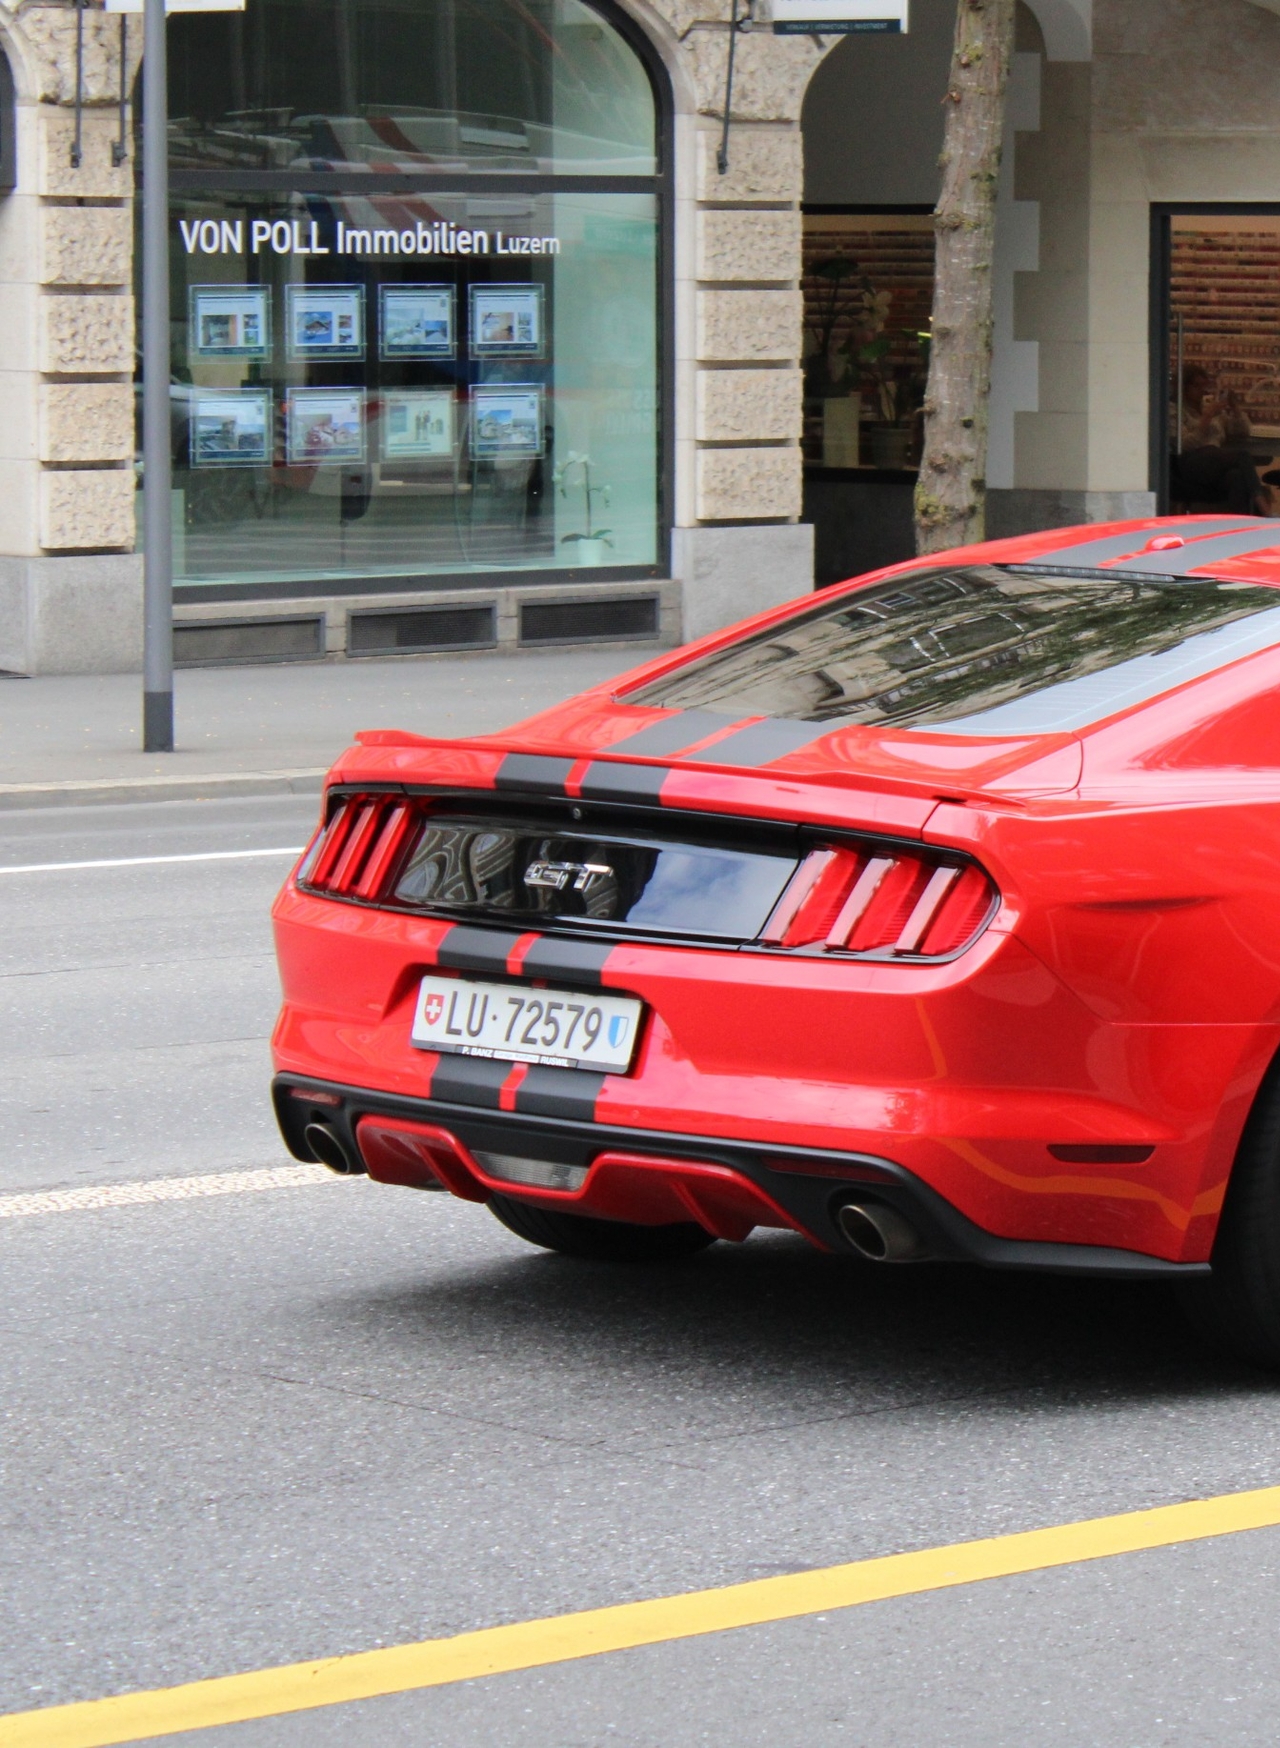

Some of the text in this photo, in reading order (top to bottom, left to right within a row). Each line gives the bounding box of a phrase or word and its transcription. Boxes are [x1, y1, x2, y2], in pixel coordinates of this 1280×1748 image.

[180, 220, 561, 254] VON POLL Immobilien Luzern
